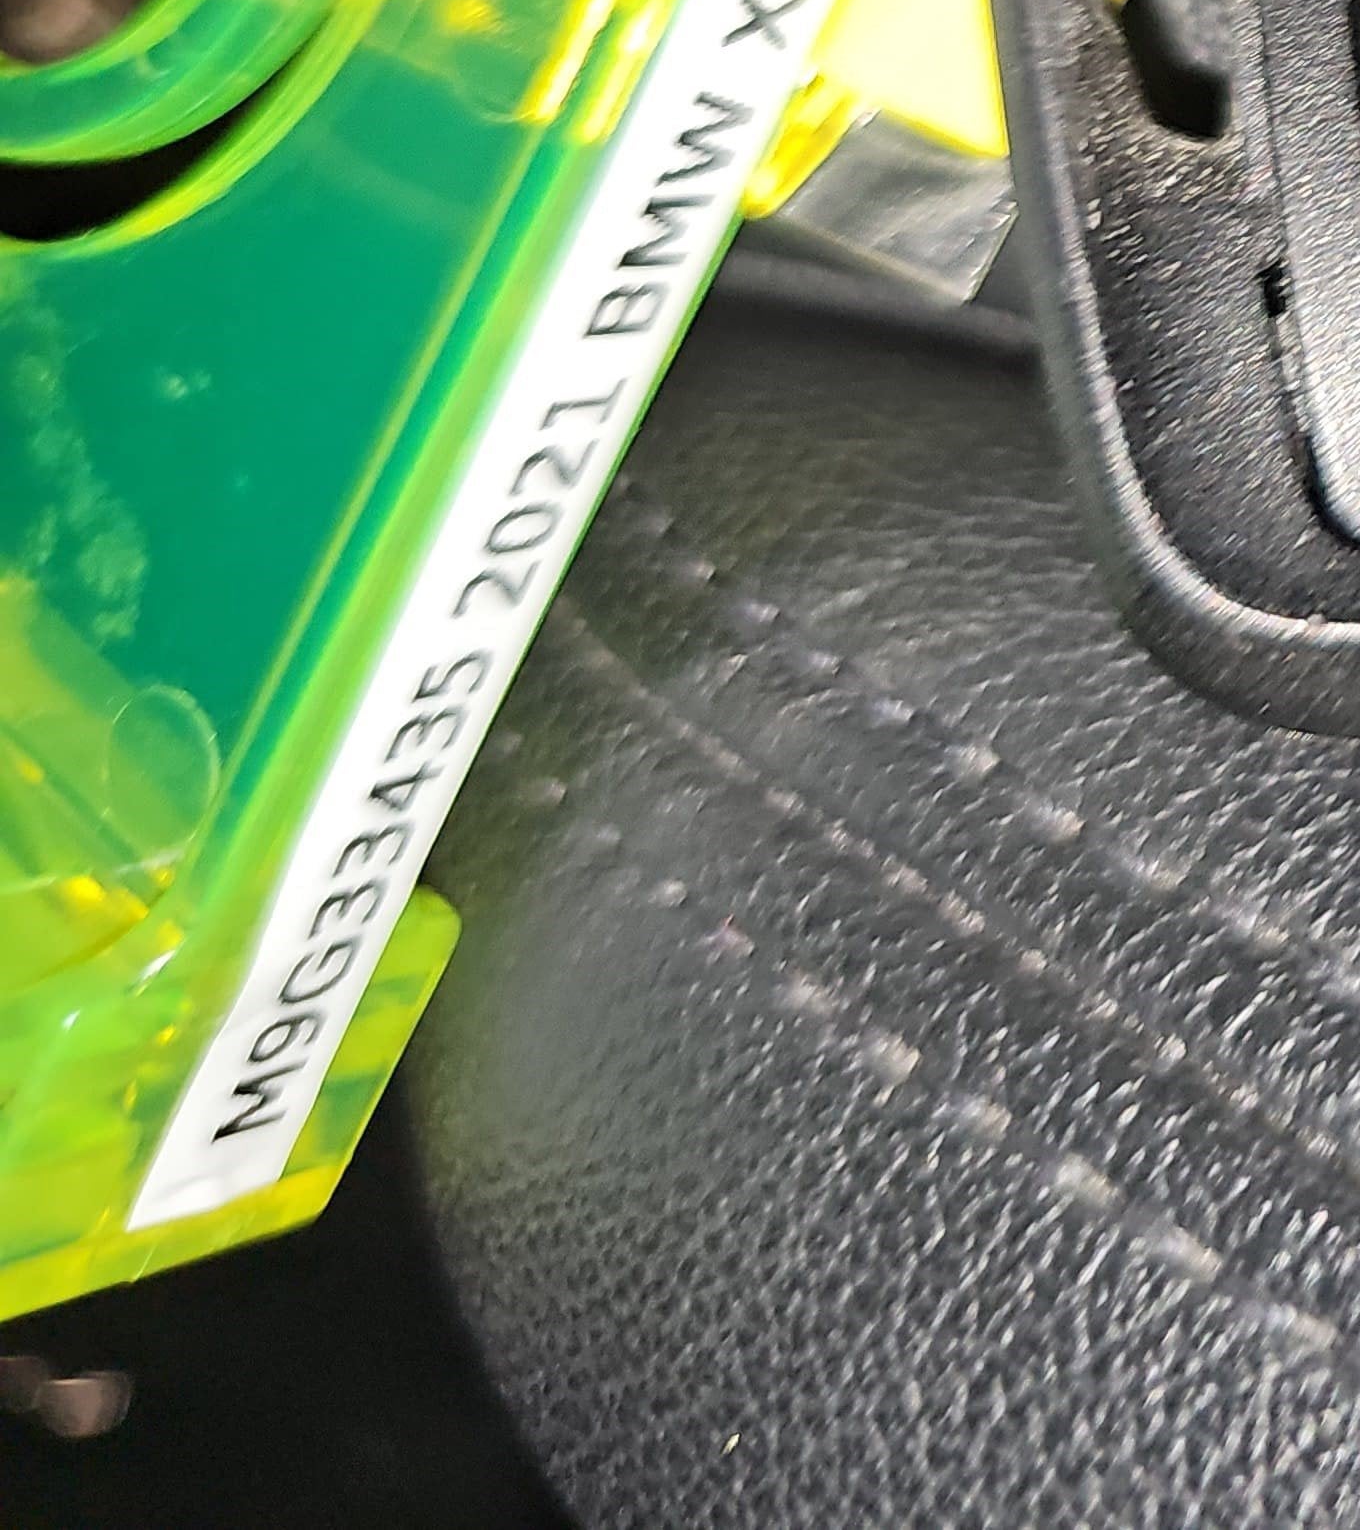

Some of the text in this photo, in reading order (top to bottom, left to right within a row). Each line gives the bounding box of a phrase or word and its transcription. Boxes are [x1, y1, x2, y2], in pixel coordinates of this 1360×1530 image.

[212, 646, 494, 1144] M9G33435
[450, 376, 630, 618] 2021
[582, 90, 756, 340] BMW
